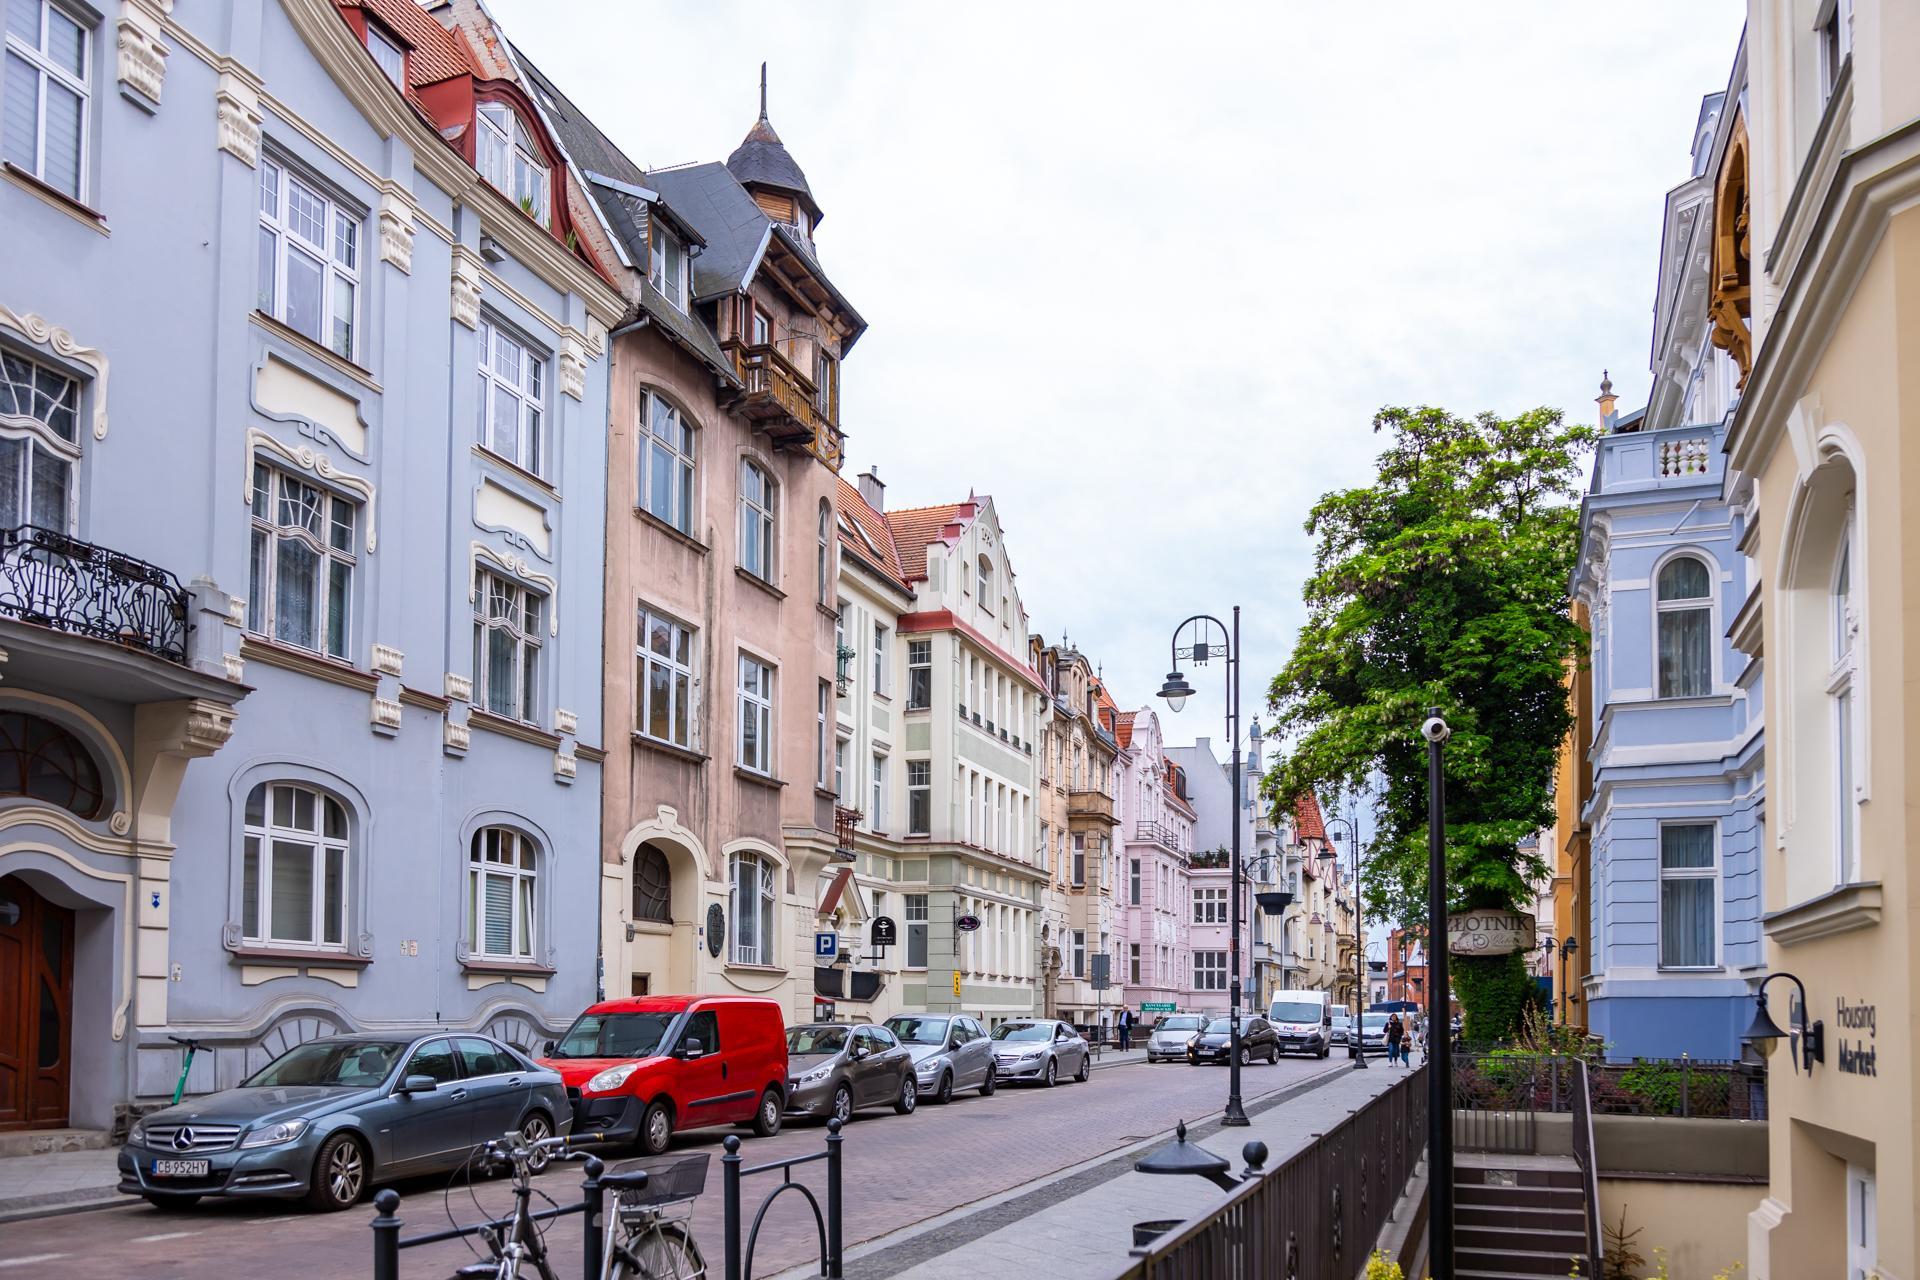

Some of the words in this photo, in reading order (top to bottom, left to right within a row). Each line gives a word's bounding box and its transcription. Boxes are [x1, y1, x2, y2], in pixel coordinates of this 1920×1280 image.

[820, 936, 832, 953] P
[1837, 996, 1875, 1038] Housing
[1839, 1038, 1877, 1077] Market
[158, 1161, 170, 1173] CB
[174, 1161, 206, 1174] 952HY
